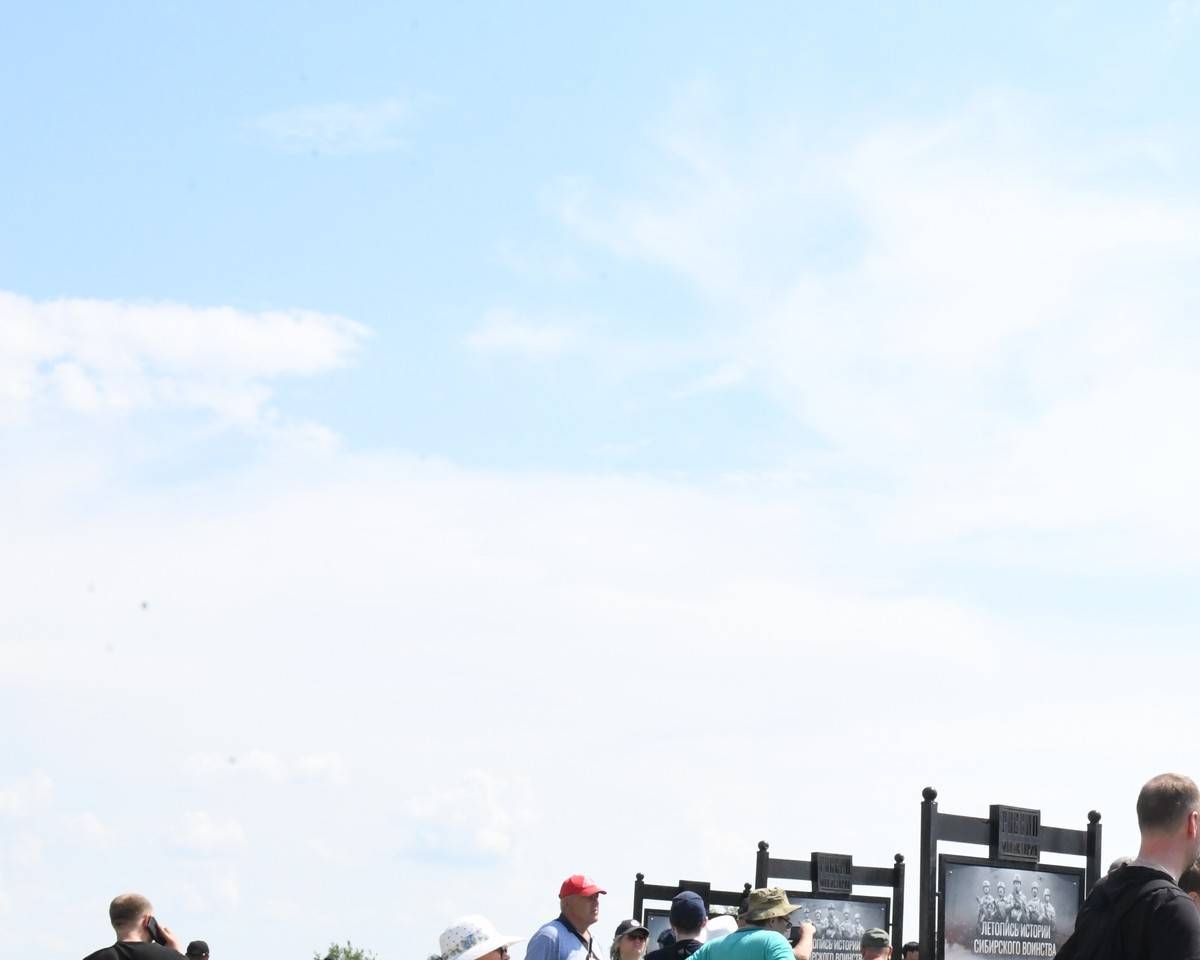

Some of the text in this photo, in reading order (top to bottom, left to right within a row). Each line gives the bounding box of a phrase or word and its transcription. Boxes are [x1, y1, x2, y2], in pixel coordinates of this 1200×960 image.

[981, 920, 1051, 939] ЛЕТОПИСЬ ИСТОРИИ
[812, 940, 833, 950] ОПИСЬ
[973, 938, 1057, 957] СИБИРСКОГО ВОИНСТВА
